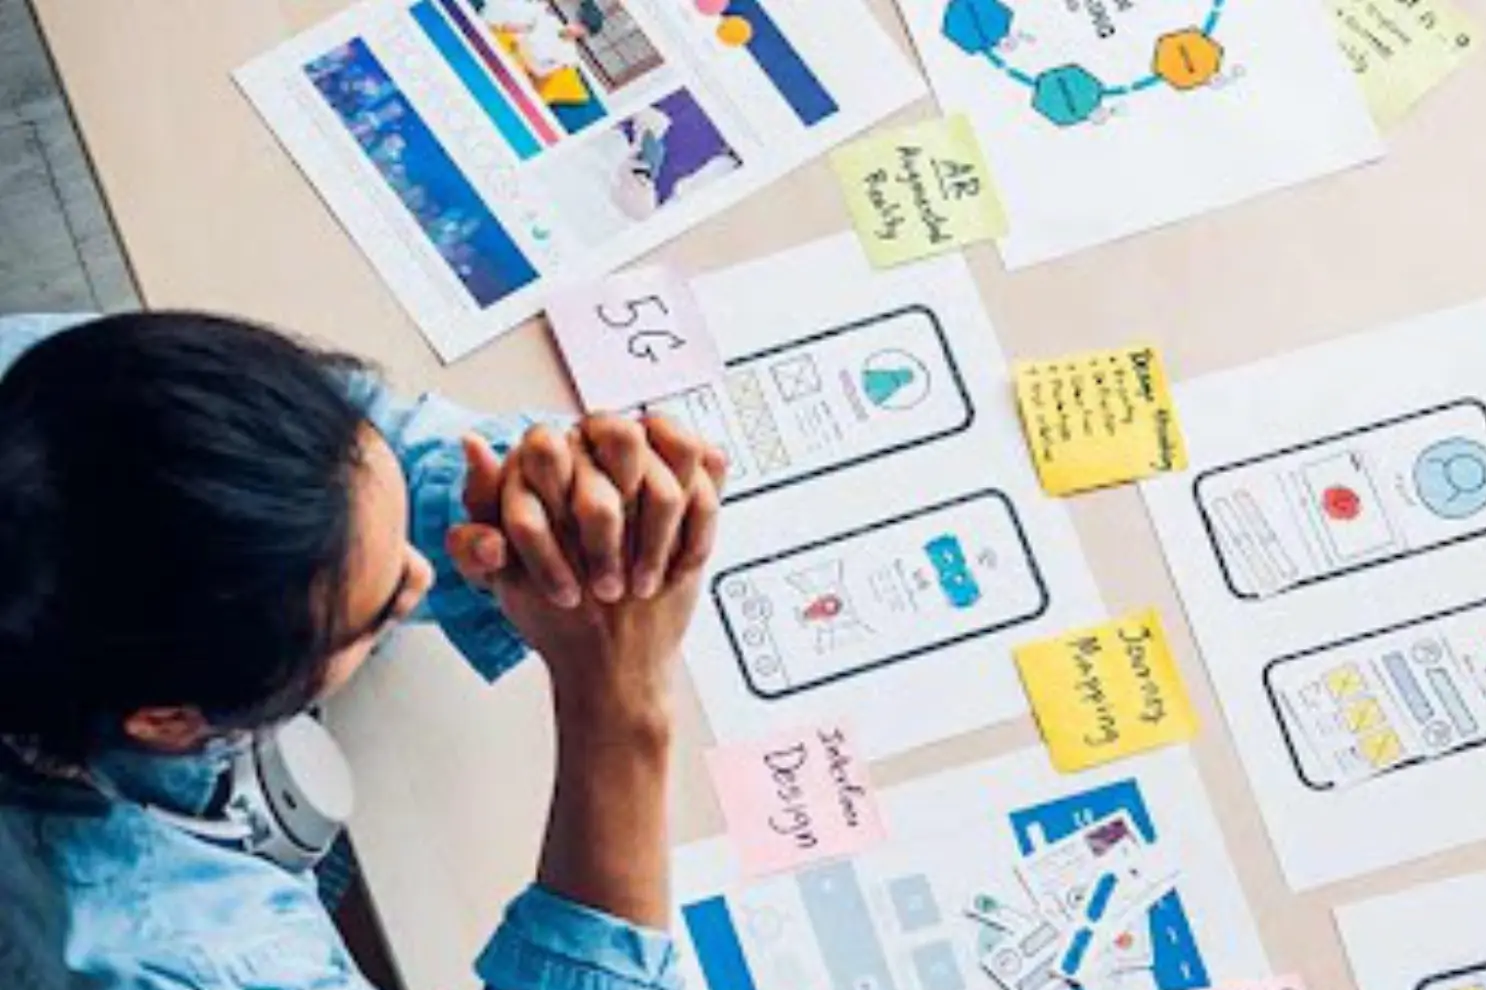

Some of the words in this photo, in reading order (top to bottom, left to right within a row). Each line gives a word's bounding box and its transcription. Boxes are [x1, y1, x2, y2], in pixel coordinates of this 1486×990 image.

[863, 167, 906, 240] Reality
[894, 145, 953, 245] Augmented
[939, 158, 981, 200] AR
[596, 294, 687, 363] 5G
[1066, 636, 1120, 746] Mapping
[1116, 626, 1167, 724] Journey
[764, 742, 818, 849] Design
